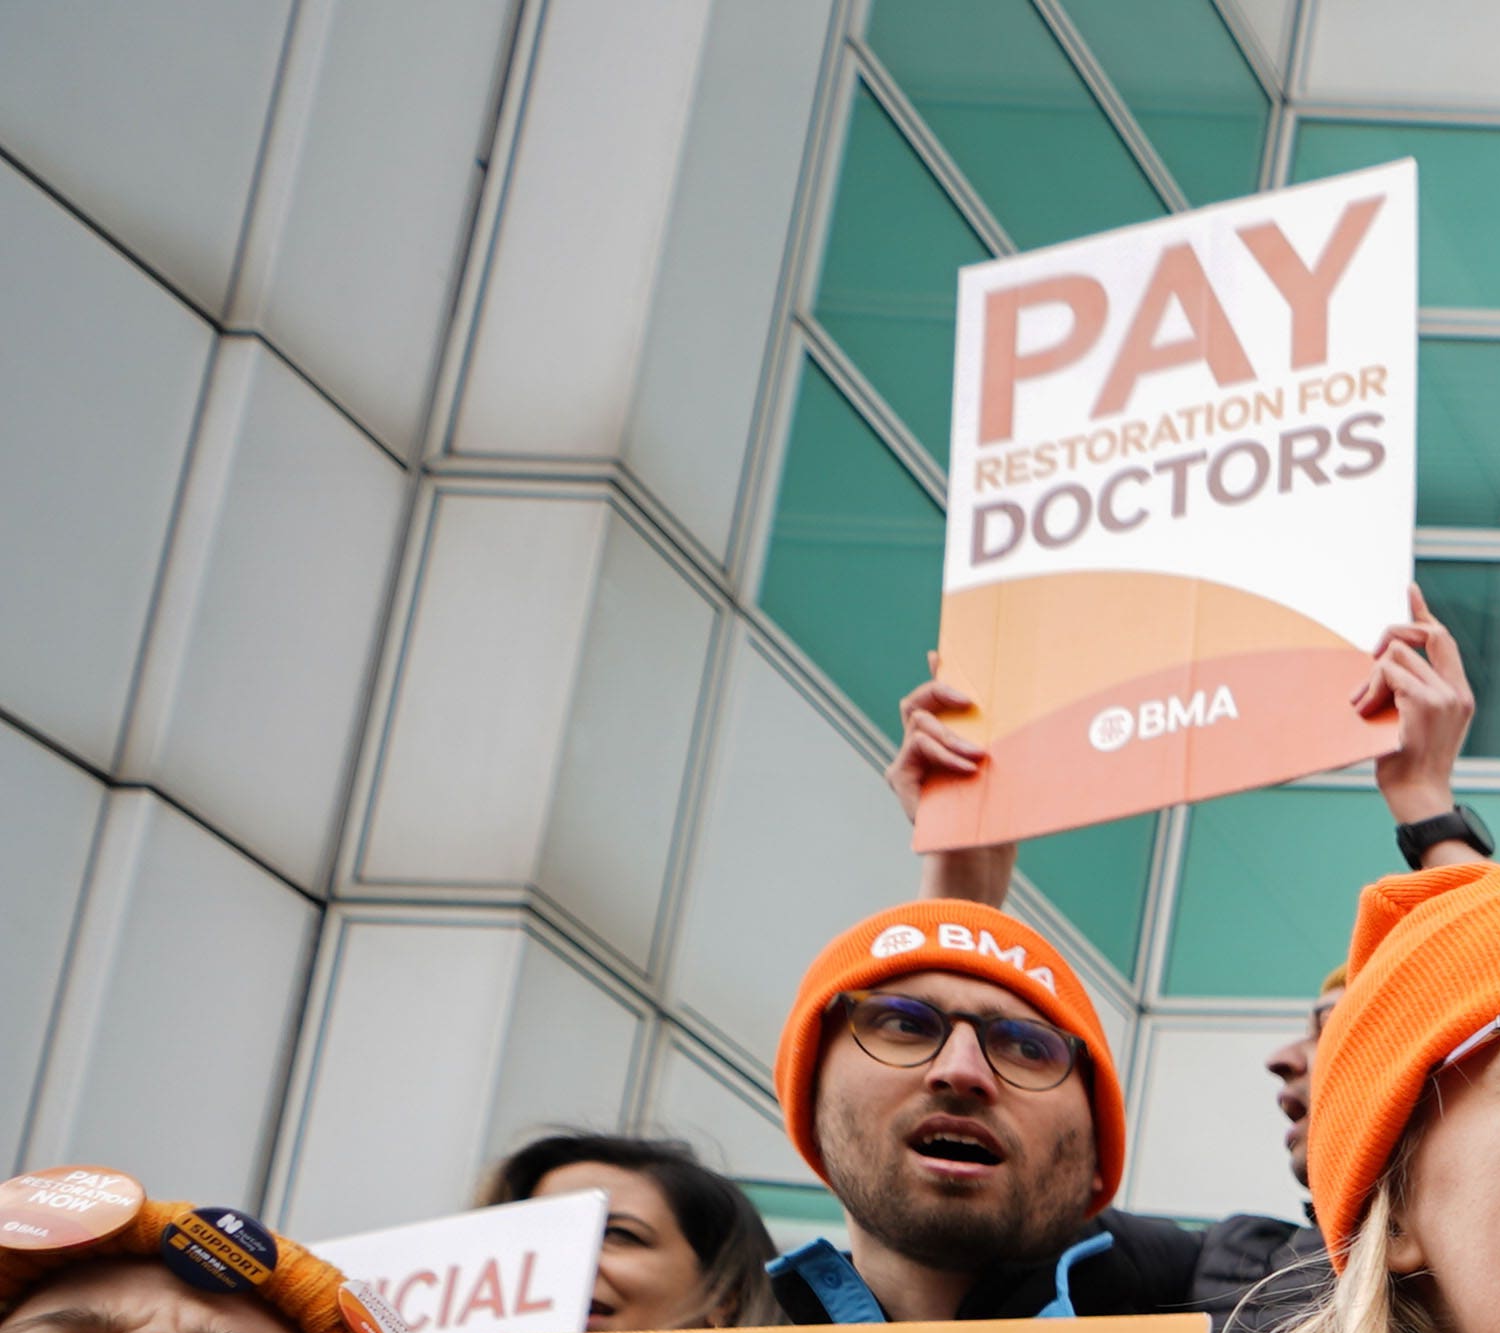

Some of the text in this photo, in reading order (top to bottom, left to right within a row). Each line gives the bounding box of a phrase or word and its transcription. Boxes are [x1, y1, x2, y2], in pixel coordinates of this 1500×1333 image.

[977, 193, 1388, 447] PAY
[972, 364, 1389, 494] RESTORATION FOR
[969, 411, 1386, 569] DOCTORS
[1137, 684, 1239, 741] BMA
[938, 923, 1059, 998] BMA
[28, 1190, 98, 1212] NOW
[64, 1170, 121, 1189] PAY
[190, 1223, 263, 1276] SUPPORT
